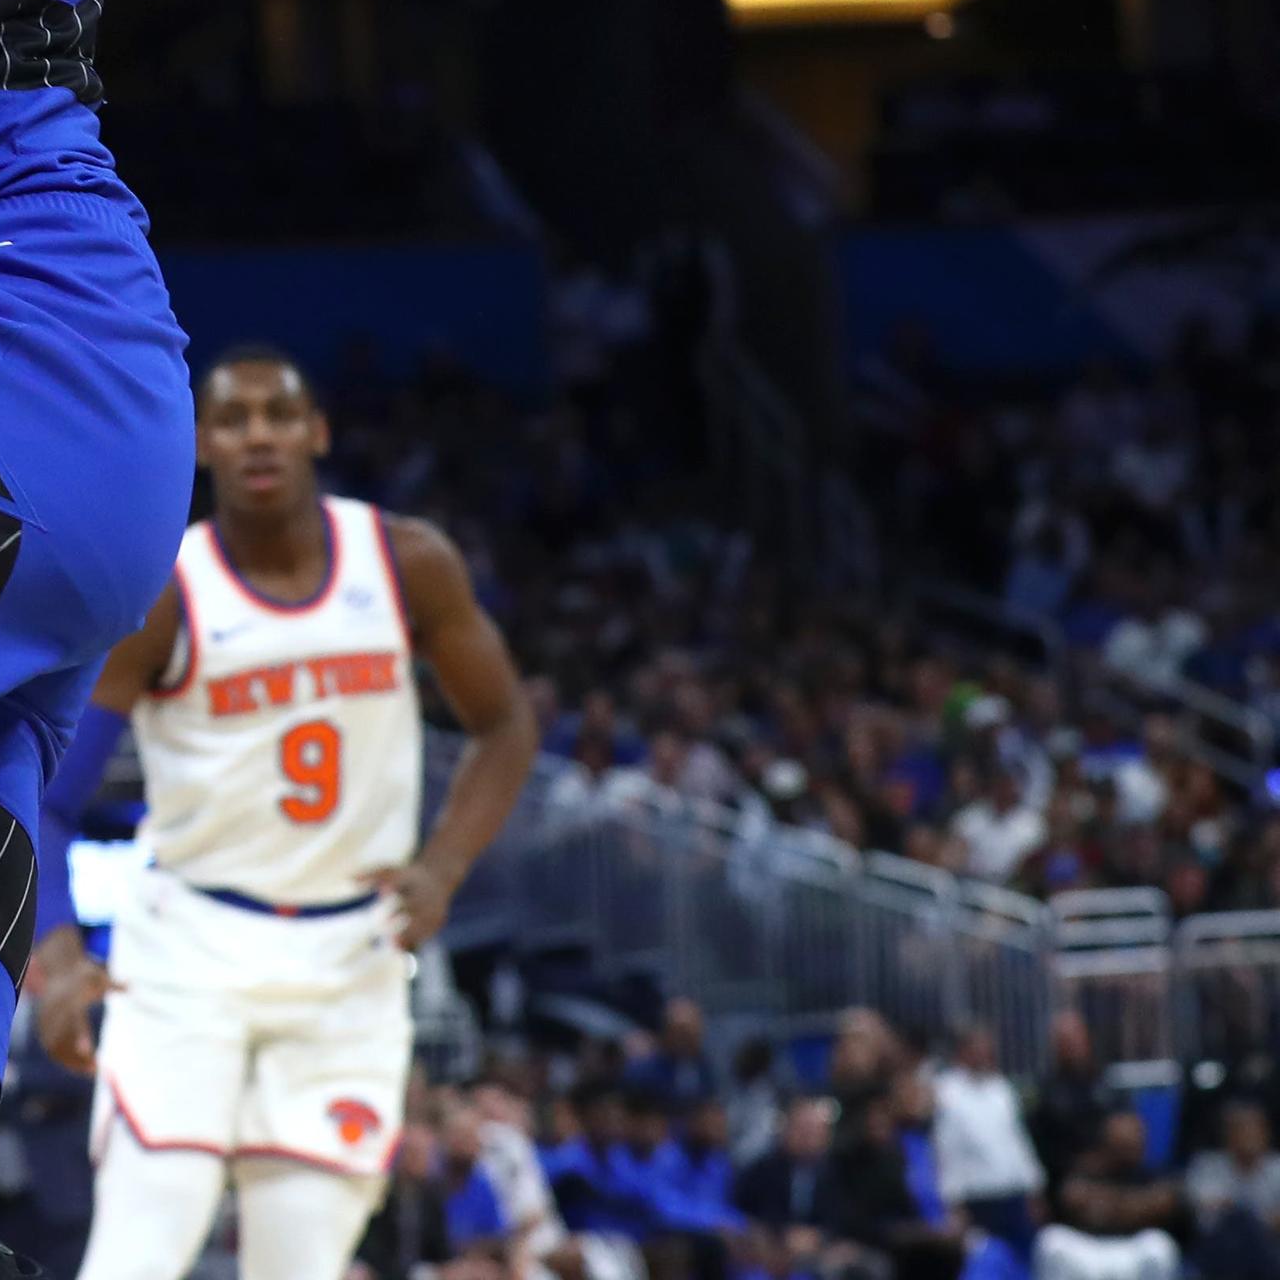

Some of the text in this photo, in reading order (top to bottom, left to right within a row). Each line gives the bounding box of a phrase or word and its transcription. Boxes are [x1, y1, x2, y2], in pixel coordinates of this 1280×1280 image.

[207, 650, 398, 716] NEW YORK
[279, 719, 341, 825] 9
